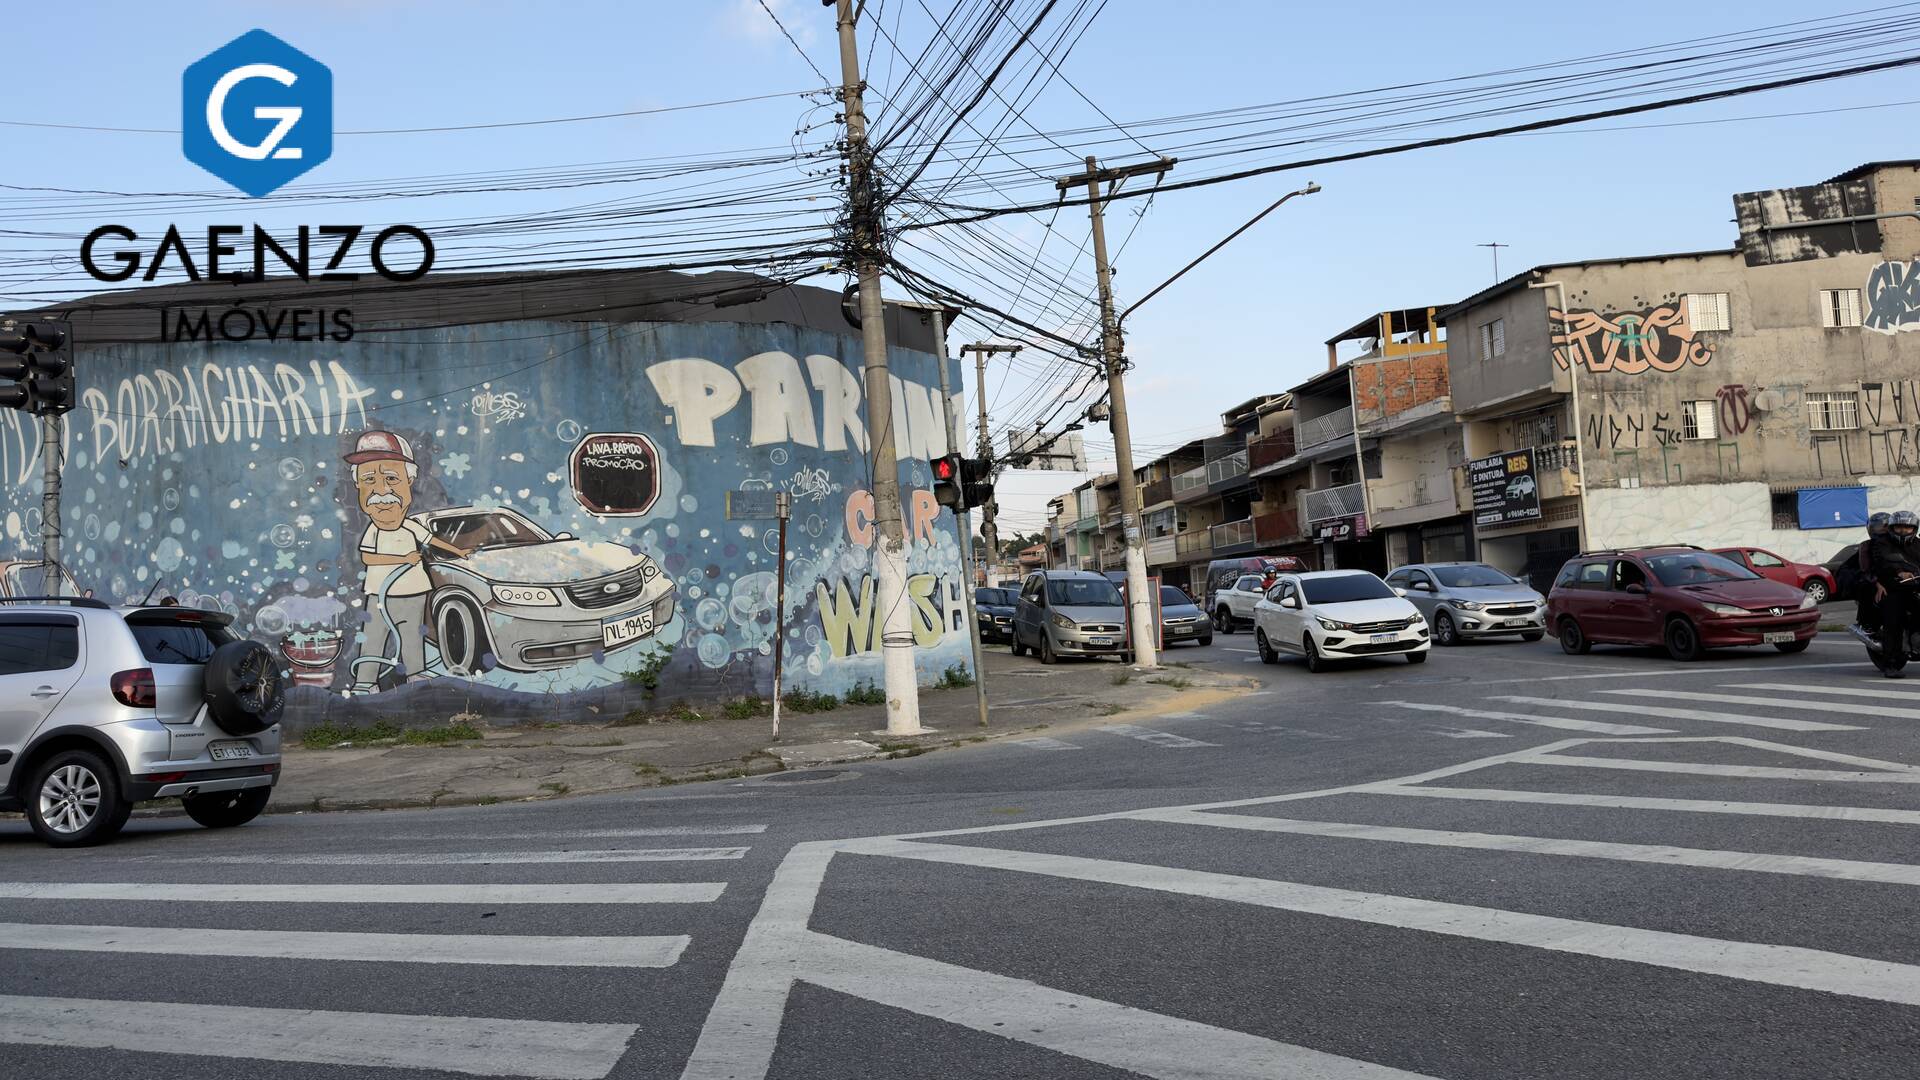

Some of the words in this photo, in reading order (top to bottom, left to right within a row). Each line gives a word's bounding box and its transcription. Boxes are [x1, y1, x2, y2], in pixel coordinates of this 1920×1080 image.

[1470, 457, 1503, 471] FUNILARIA
[1507, 455, 1528, 473] REIS
[1473, 474, 1478, 483] E
[1479, 468, 1504, 482] PINTURA
[846, 490, 939, 549] CR
[1320, 525, 1350, 538] M&D
